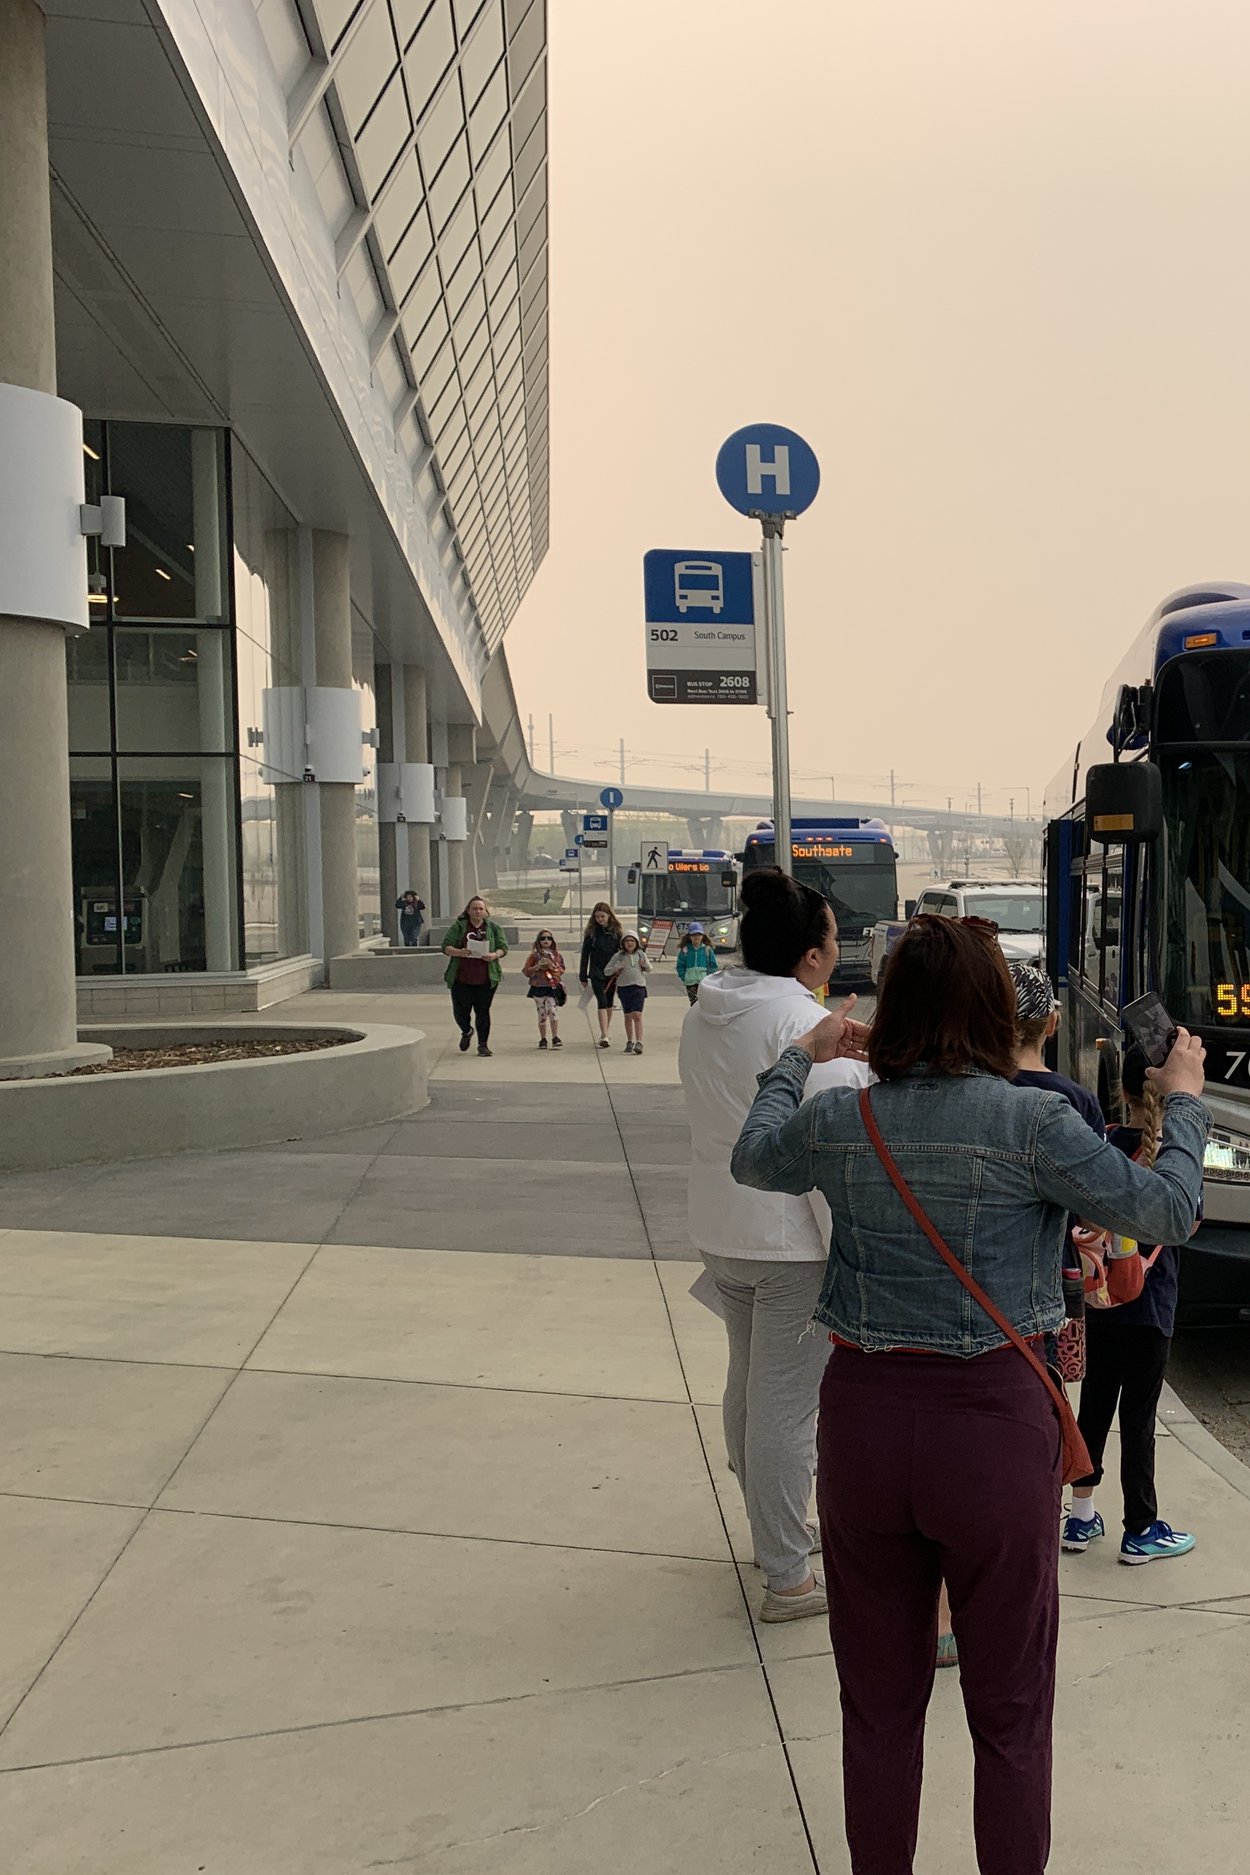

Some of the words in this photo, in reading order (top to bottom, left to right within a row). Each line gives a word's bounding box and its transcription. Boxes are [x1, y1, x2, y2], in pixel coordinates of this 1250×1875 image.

[745, 444, 791, 495] H
[650, 629, 679, 642] 502
[694, 631, 716, 640] South
[717, 631, 746, 642] Campus
[719, 676, 750, 688] 2608
[792, 844, 853, 858] Southgate
